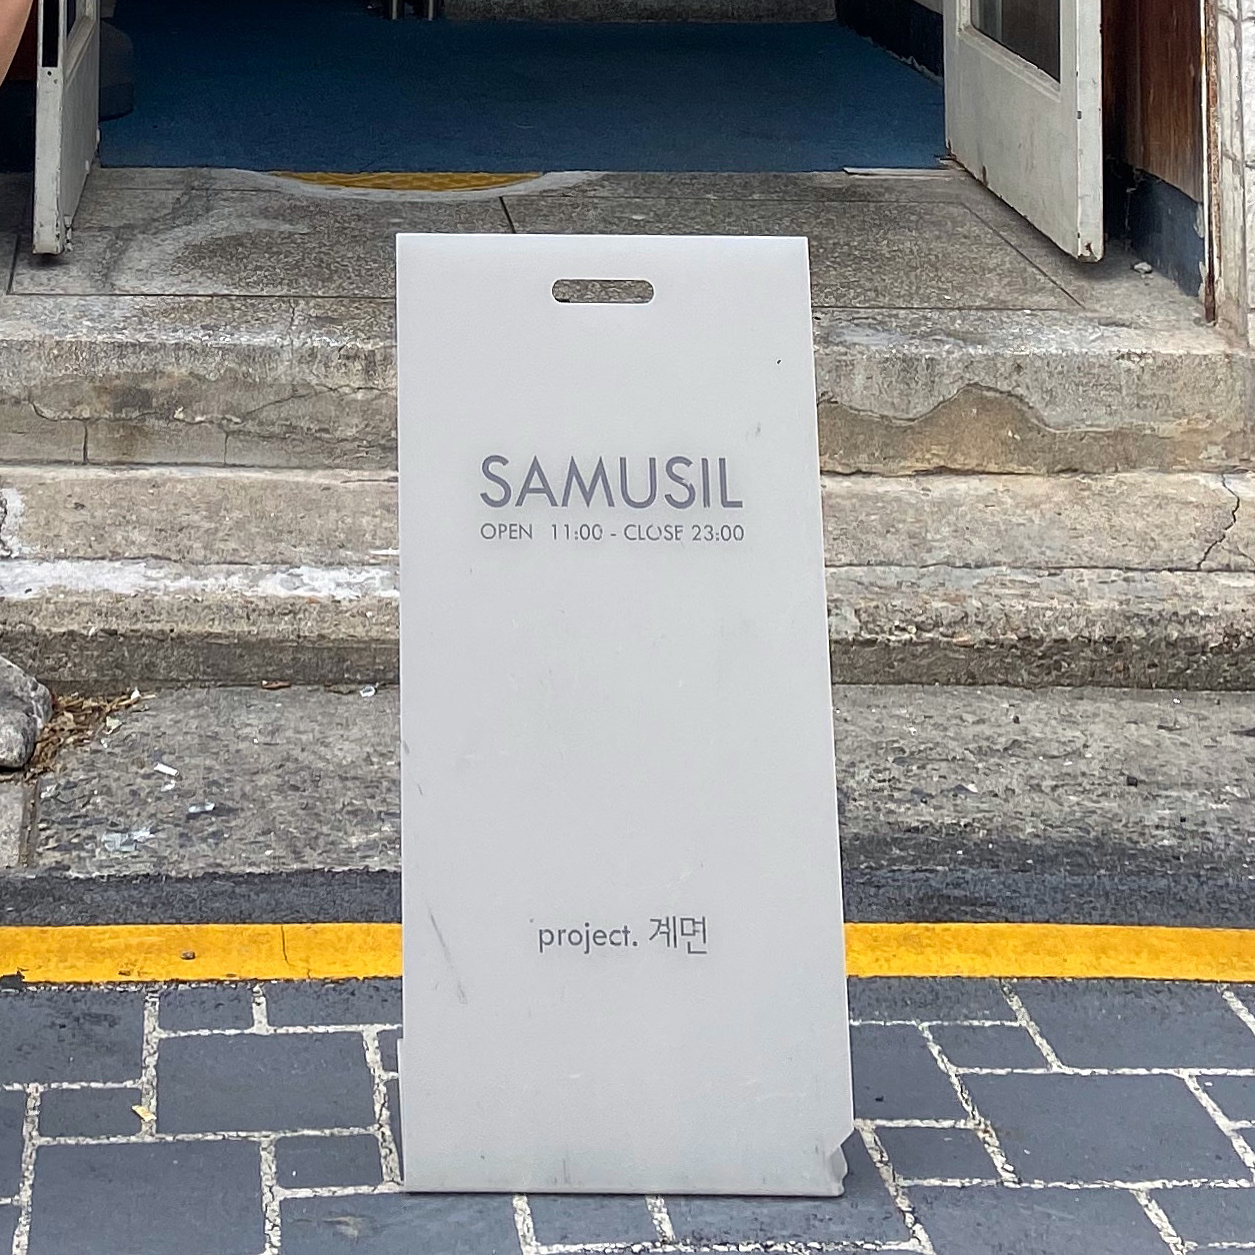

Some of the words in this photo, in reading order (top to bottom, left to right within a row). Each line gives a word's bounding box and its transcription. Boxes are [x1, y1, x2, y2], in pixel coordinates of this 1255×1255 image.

[479, 454, 743, 509] SAMUSIL
[480, 523, 533, 541] OPEN
[551, 523, 603, 541] 11:00
[624, 523, 684, 541] CLOSE
[691, 523, 745, 542] 23:00
[538, 922, 639, 954] project.
[649, 915, 708, 955] 계면
